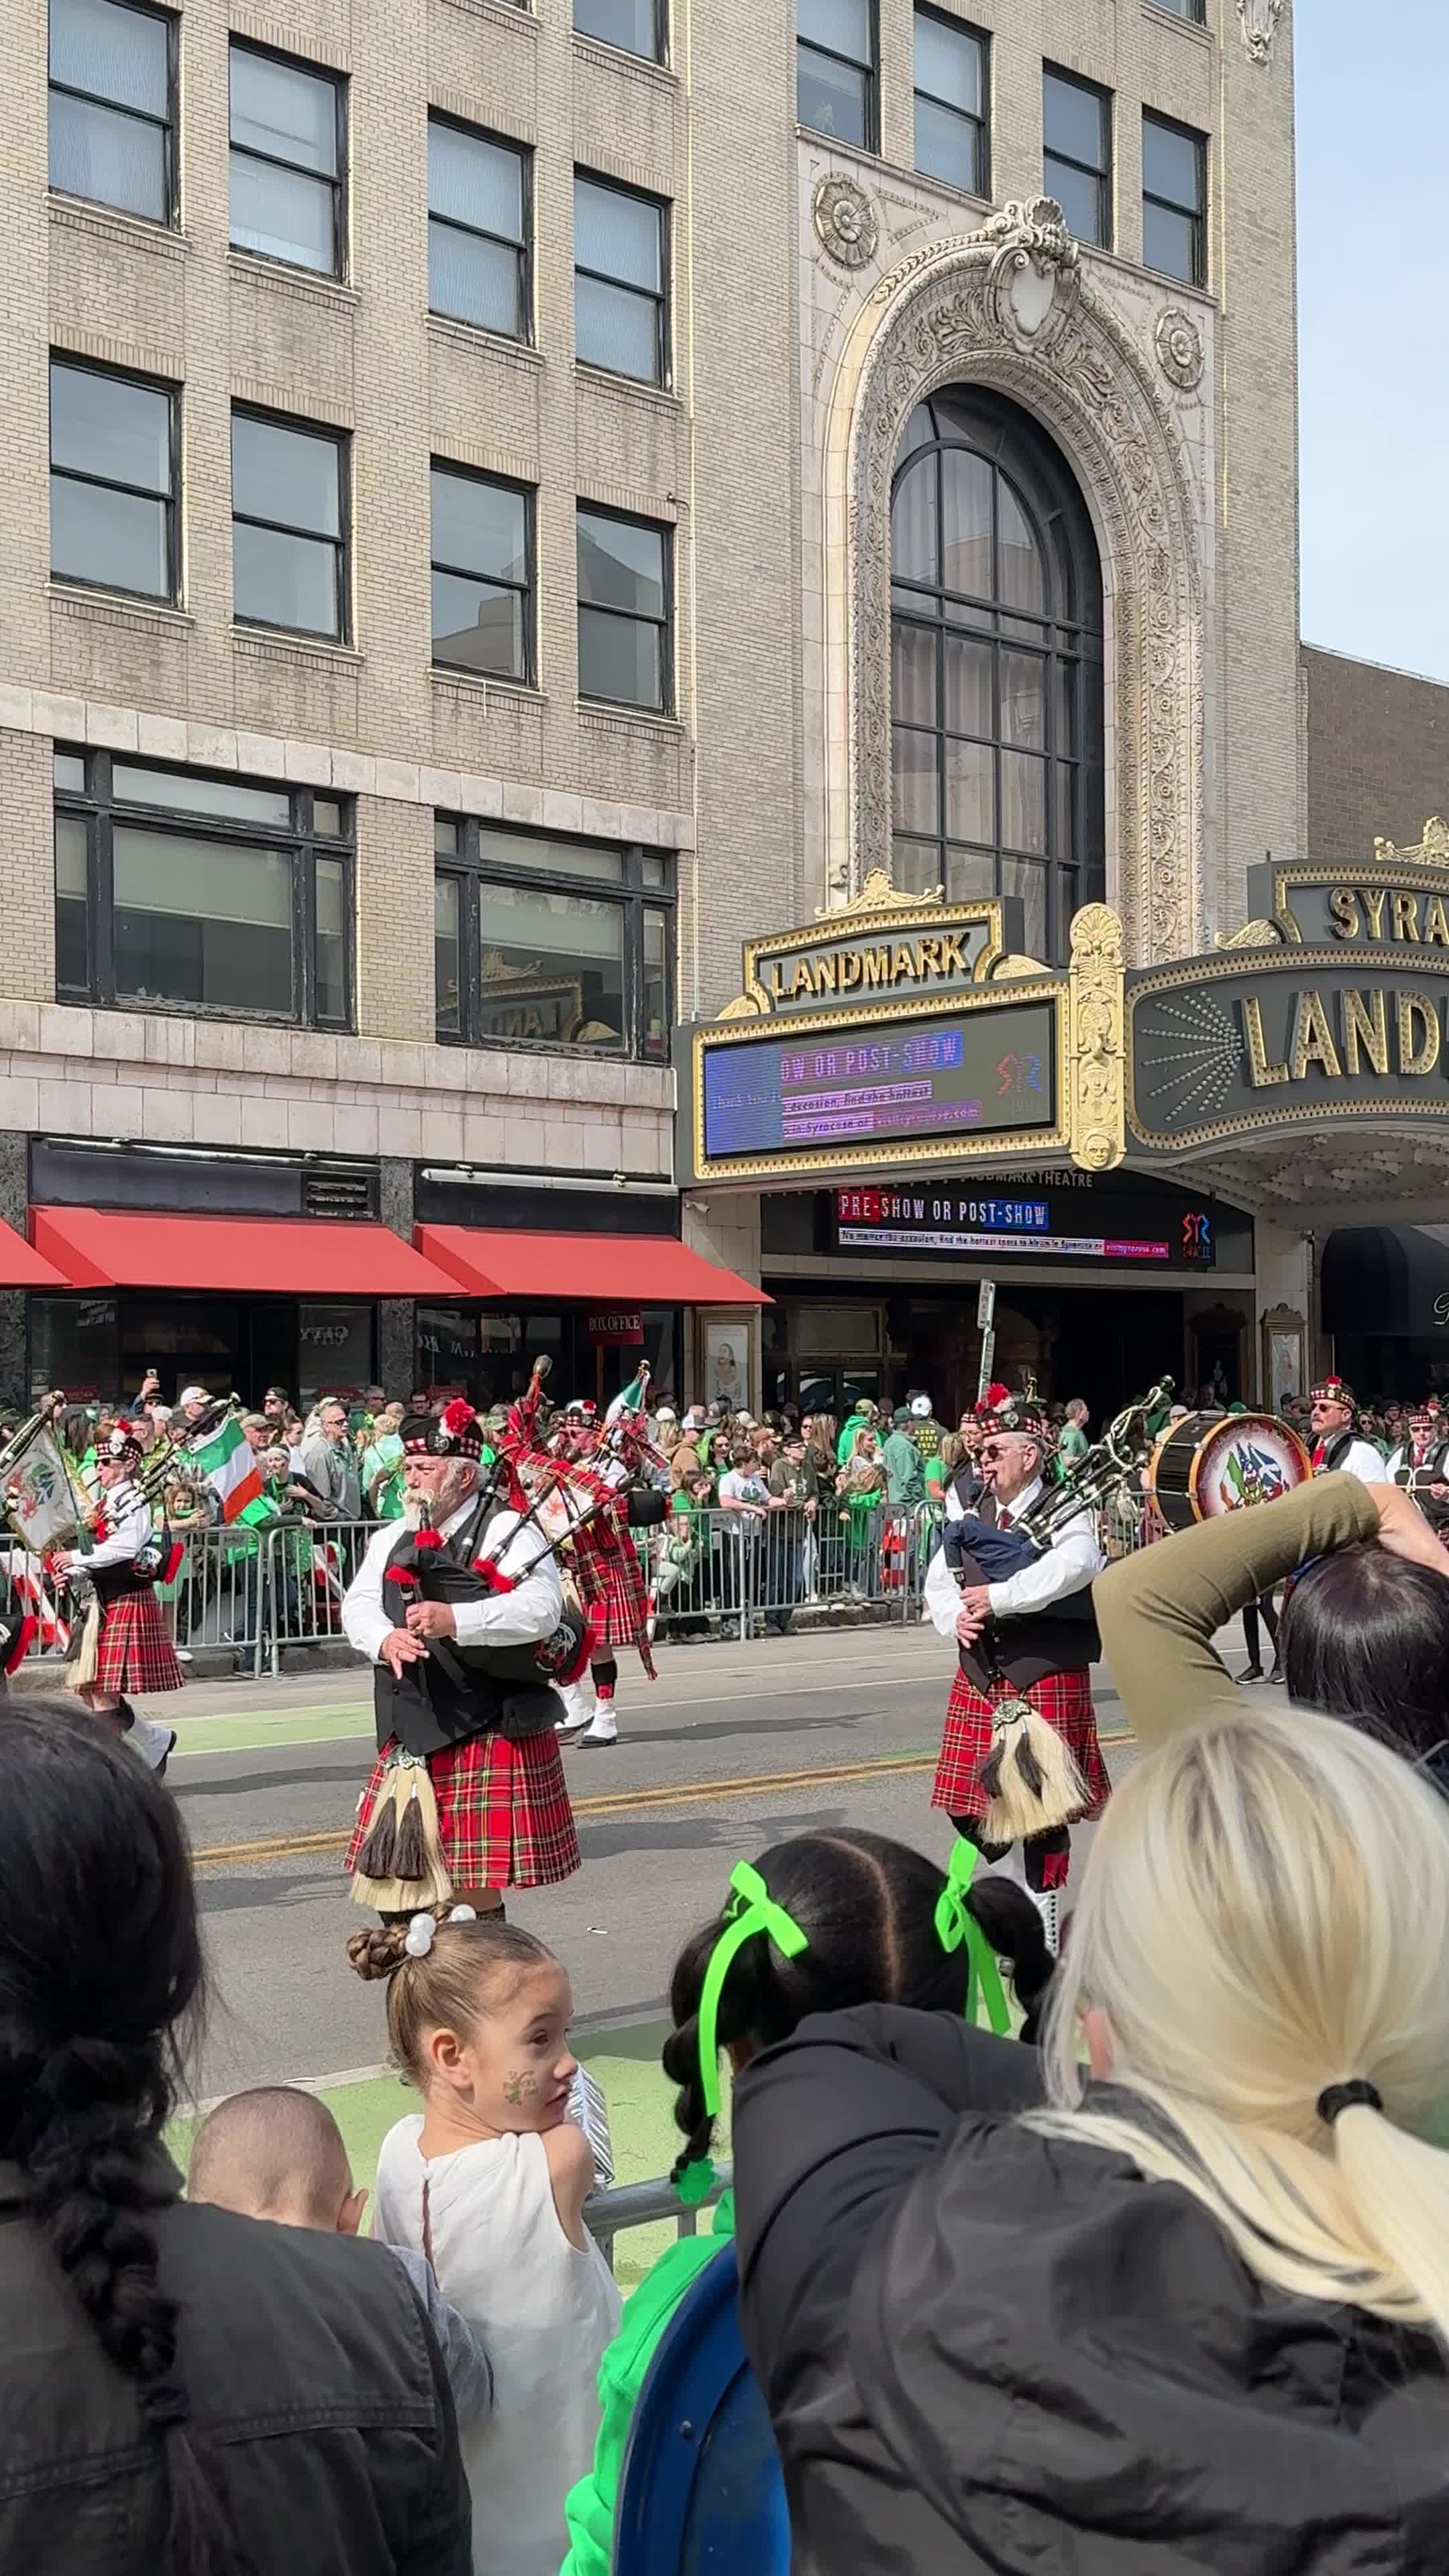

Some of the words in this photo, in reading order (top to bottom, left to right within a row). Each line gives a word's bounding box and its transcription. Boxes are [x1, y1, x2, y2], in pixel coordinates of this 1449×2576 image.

[772, 932, 970, 998] LANDMARK
[816, 1054, 837, 1077] OR
[847, 1037, 956, 1074] POST-SHOW
[1038, 1170, 1093, 1187] THEATRE
[841, 1195, 924, 1220] PRE-SHOW
[933, 1200, 951, 1221] OR
[959, 1201, 1045, 1225] POST-SHOW
[589, 1316, 608, 1332] BOX
[608, 1314, 641, 1331] OFFICE
